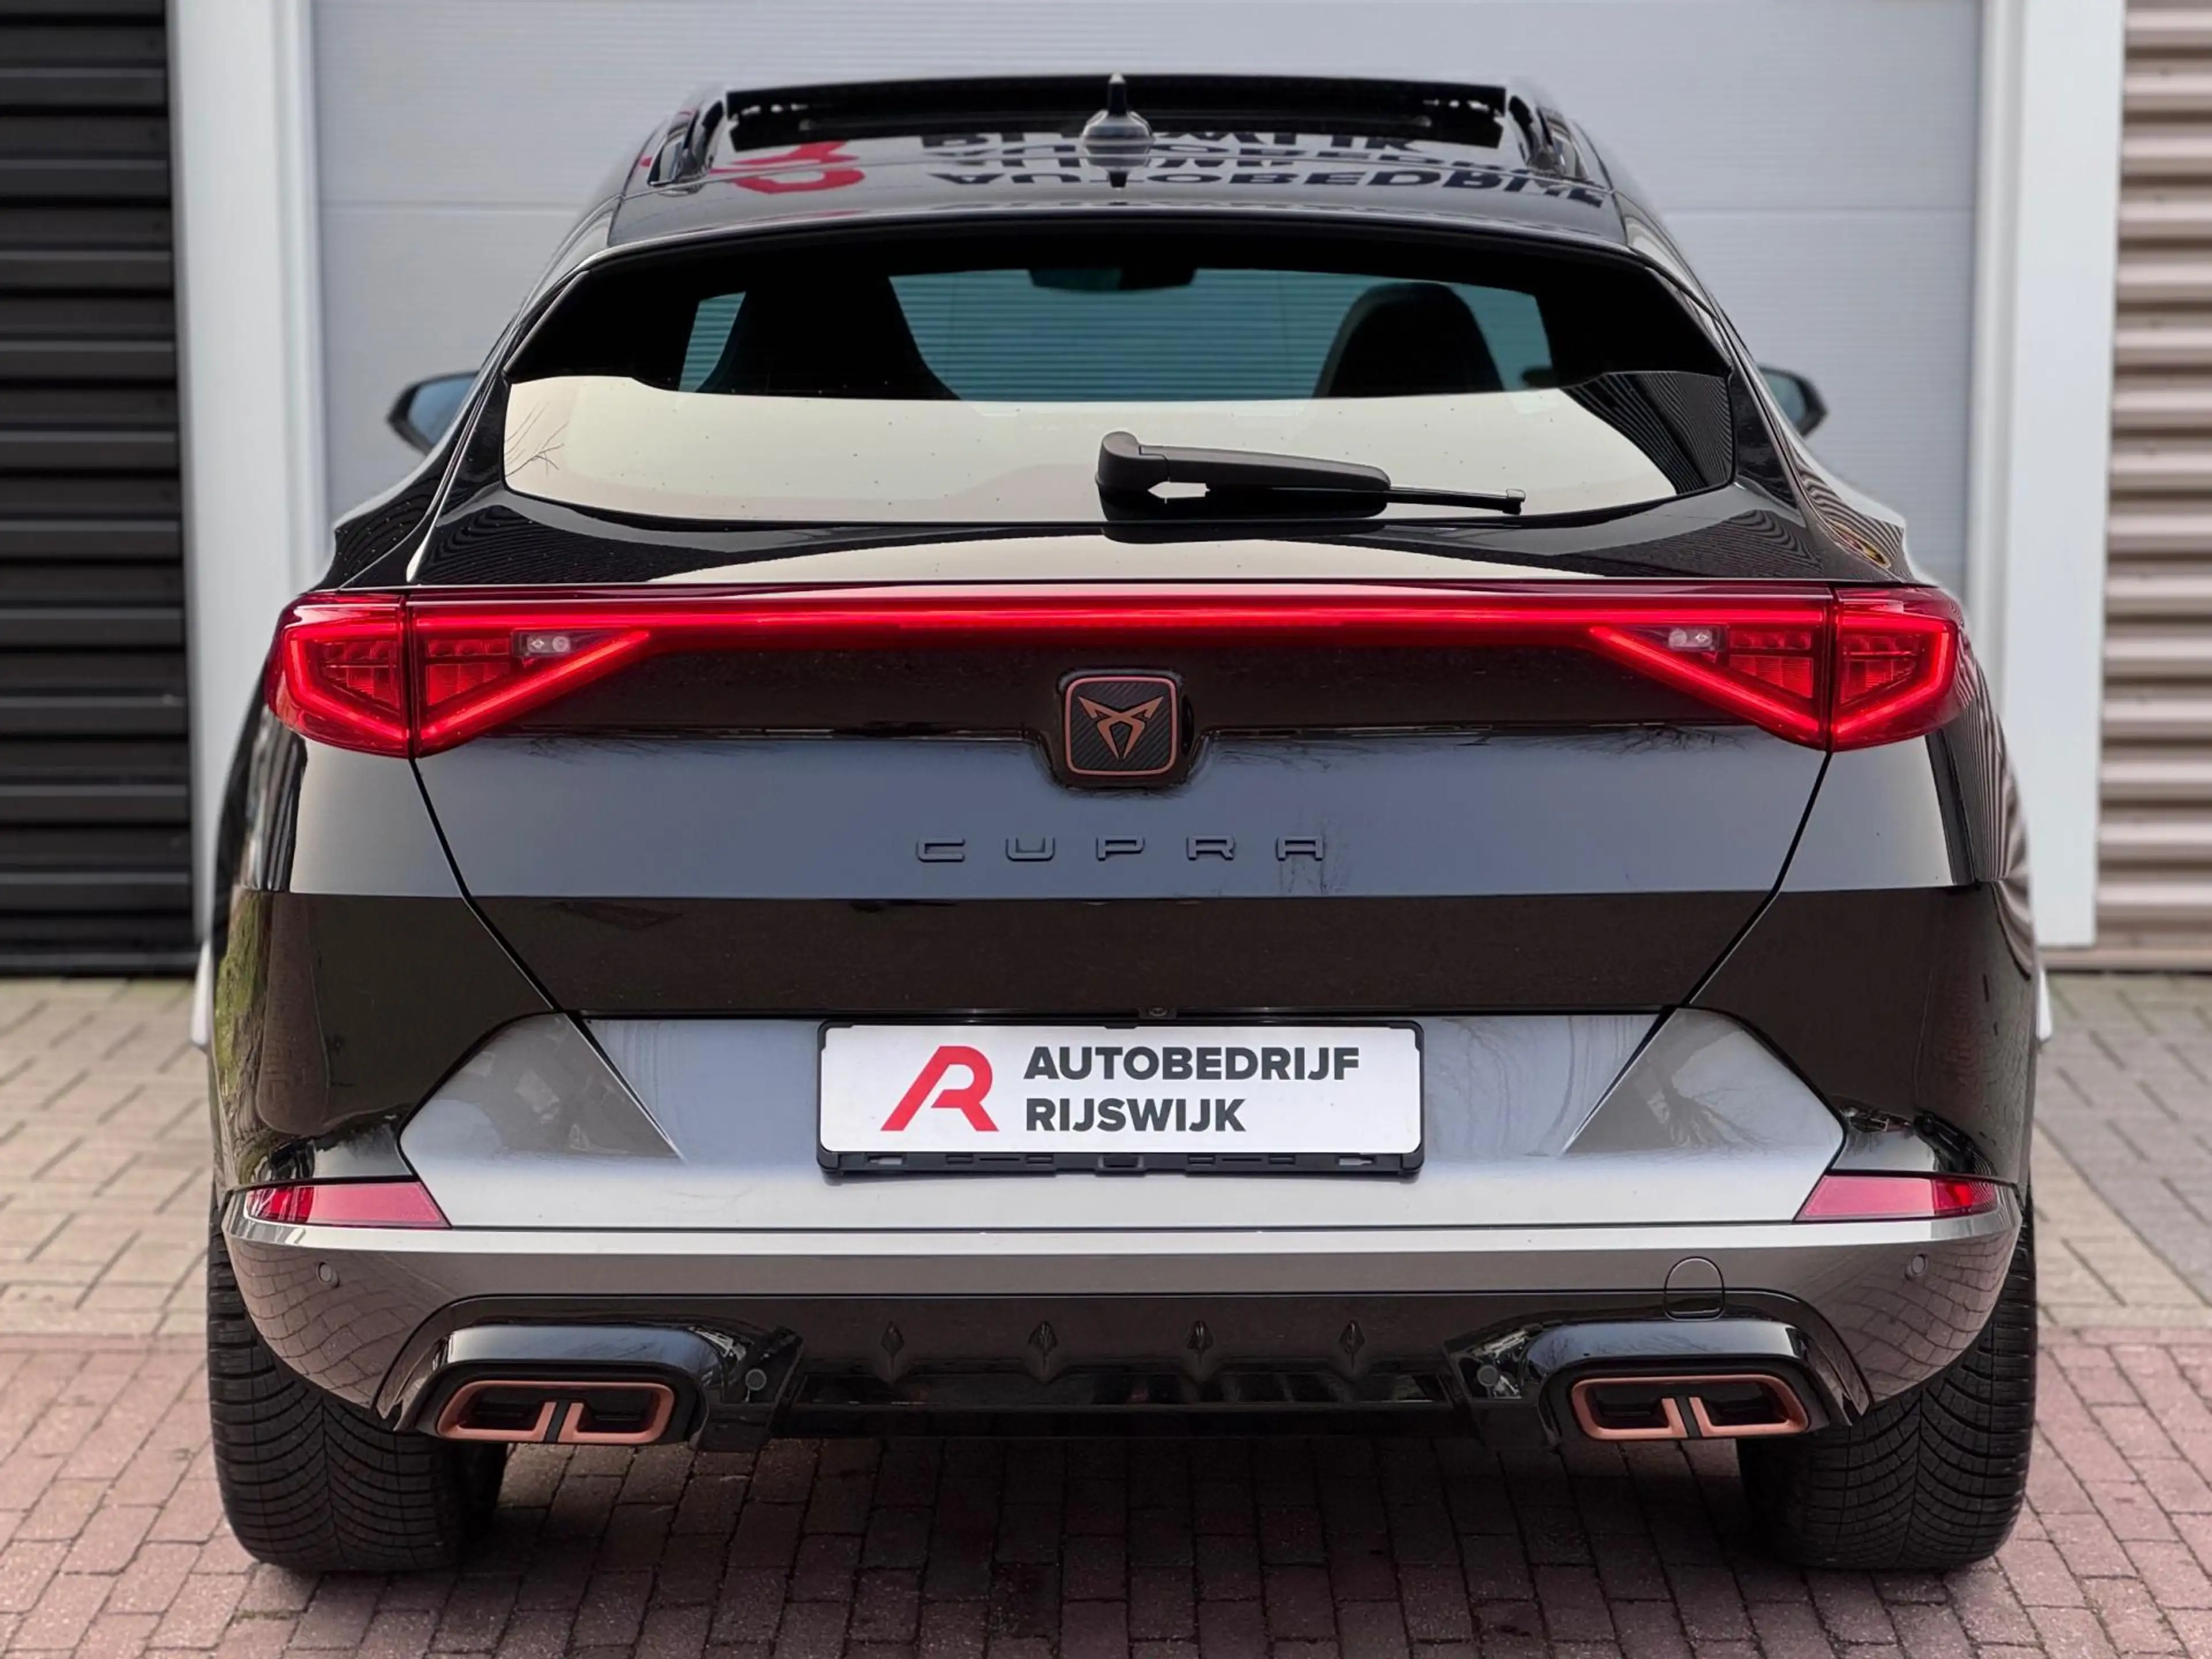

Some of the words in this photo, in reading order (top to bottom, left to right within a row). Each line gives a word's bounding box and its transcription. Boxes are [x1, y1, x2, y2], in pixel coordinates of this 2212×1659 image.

[916, 836, 1325, 863] CUPRA
[1024, 1046, 1359, 1080] AUTOBEDRIJF
[1026, 1098, 1245, 1132] RIJSWIJK
